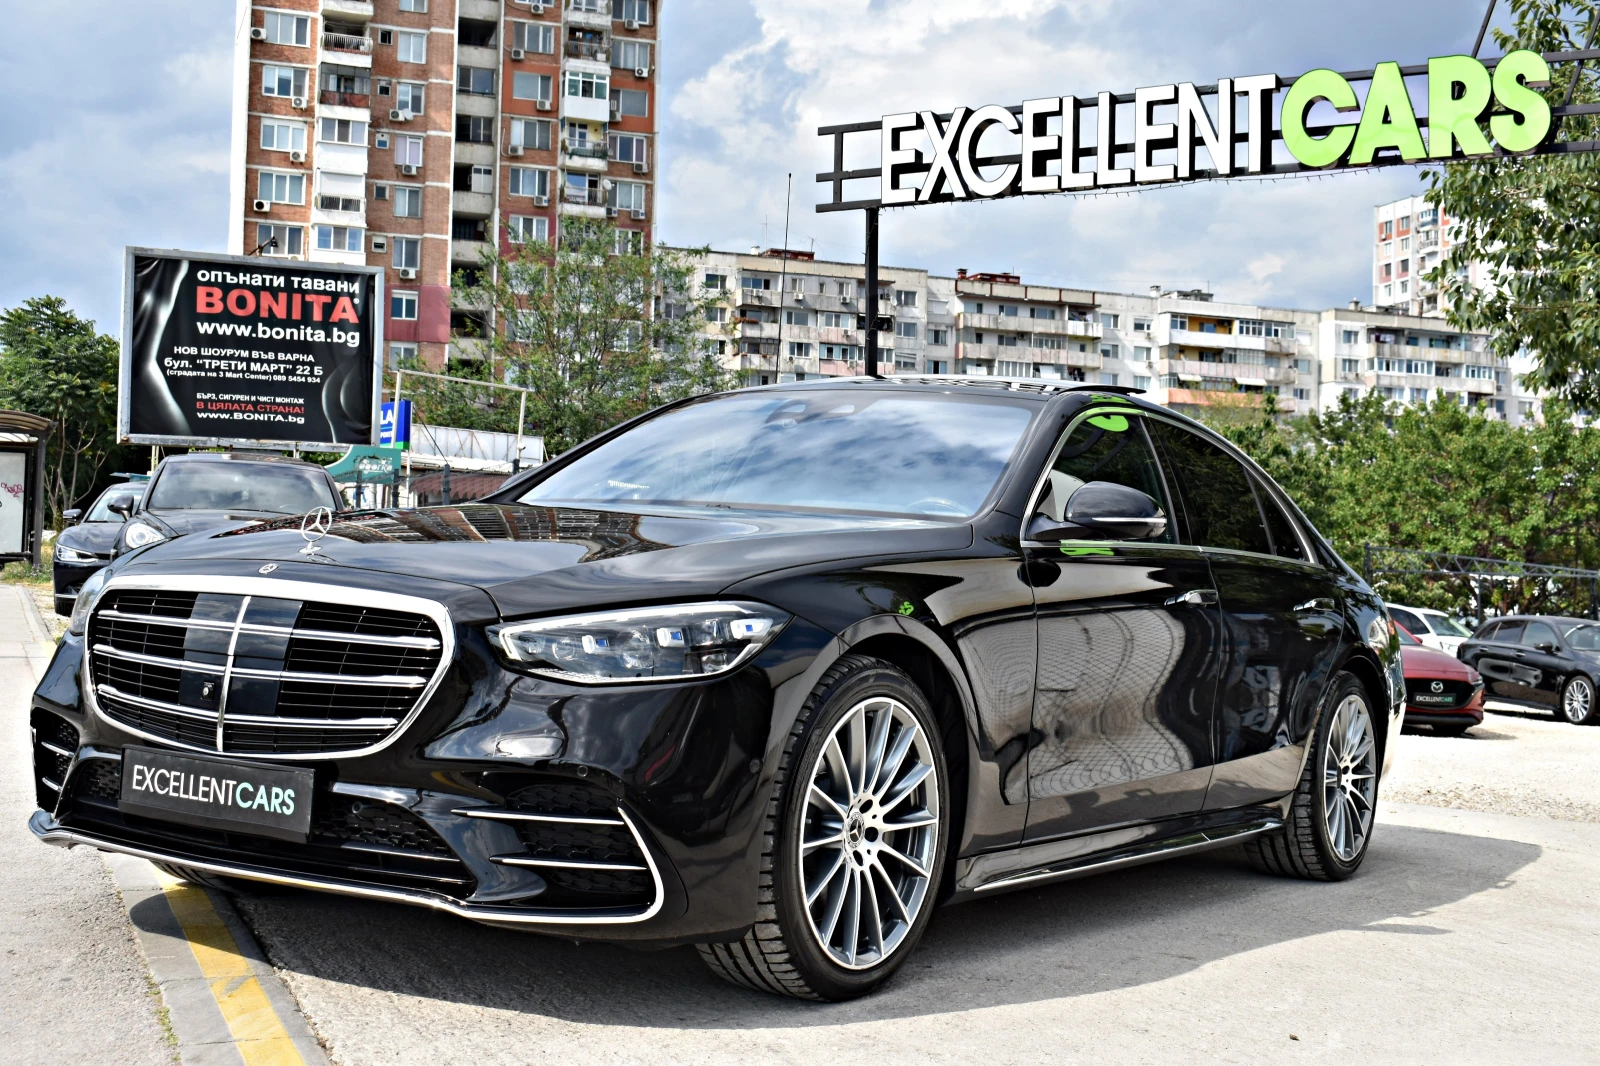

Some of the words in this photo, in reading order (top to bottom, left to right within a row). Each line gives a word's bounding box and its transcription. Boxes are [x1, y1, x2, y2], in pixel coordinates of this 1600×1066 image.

[197, 270, 284, 288] опънати
[291, 276, 360, 294] тавани
[197, 322, 360, 348] www.bonita.bg
[174, 346, 198, 355] НОВ
[201, 348, 249, 358] ШОУРУМ
[252, 351, 275, 360] ВЪВ
[278, 352, 315, 362] ВАРНА
[164, 358, 192, 369] бул.
[296, 366, 310, 375] 22
[314, 366, 323, 375] Б
[166, 369, 205, 377] (сградата
[245, 373, 272, 381] Center)
[219, 394, 249, 402] СИГУРЕН
[208, 402, 254, 411] ЦЯЛАТА
[257, 405, 305, 414] СТРАНА!
[197, 412, 305, 424] www.BONITA.bg
[132, 765, 295, 815] EXCELLENTCARS
